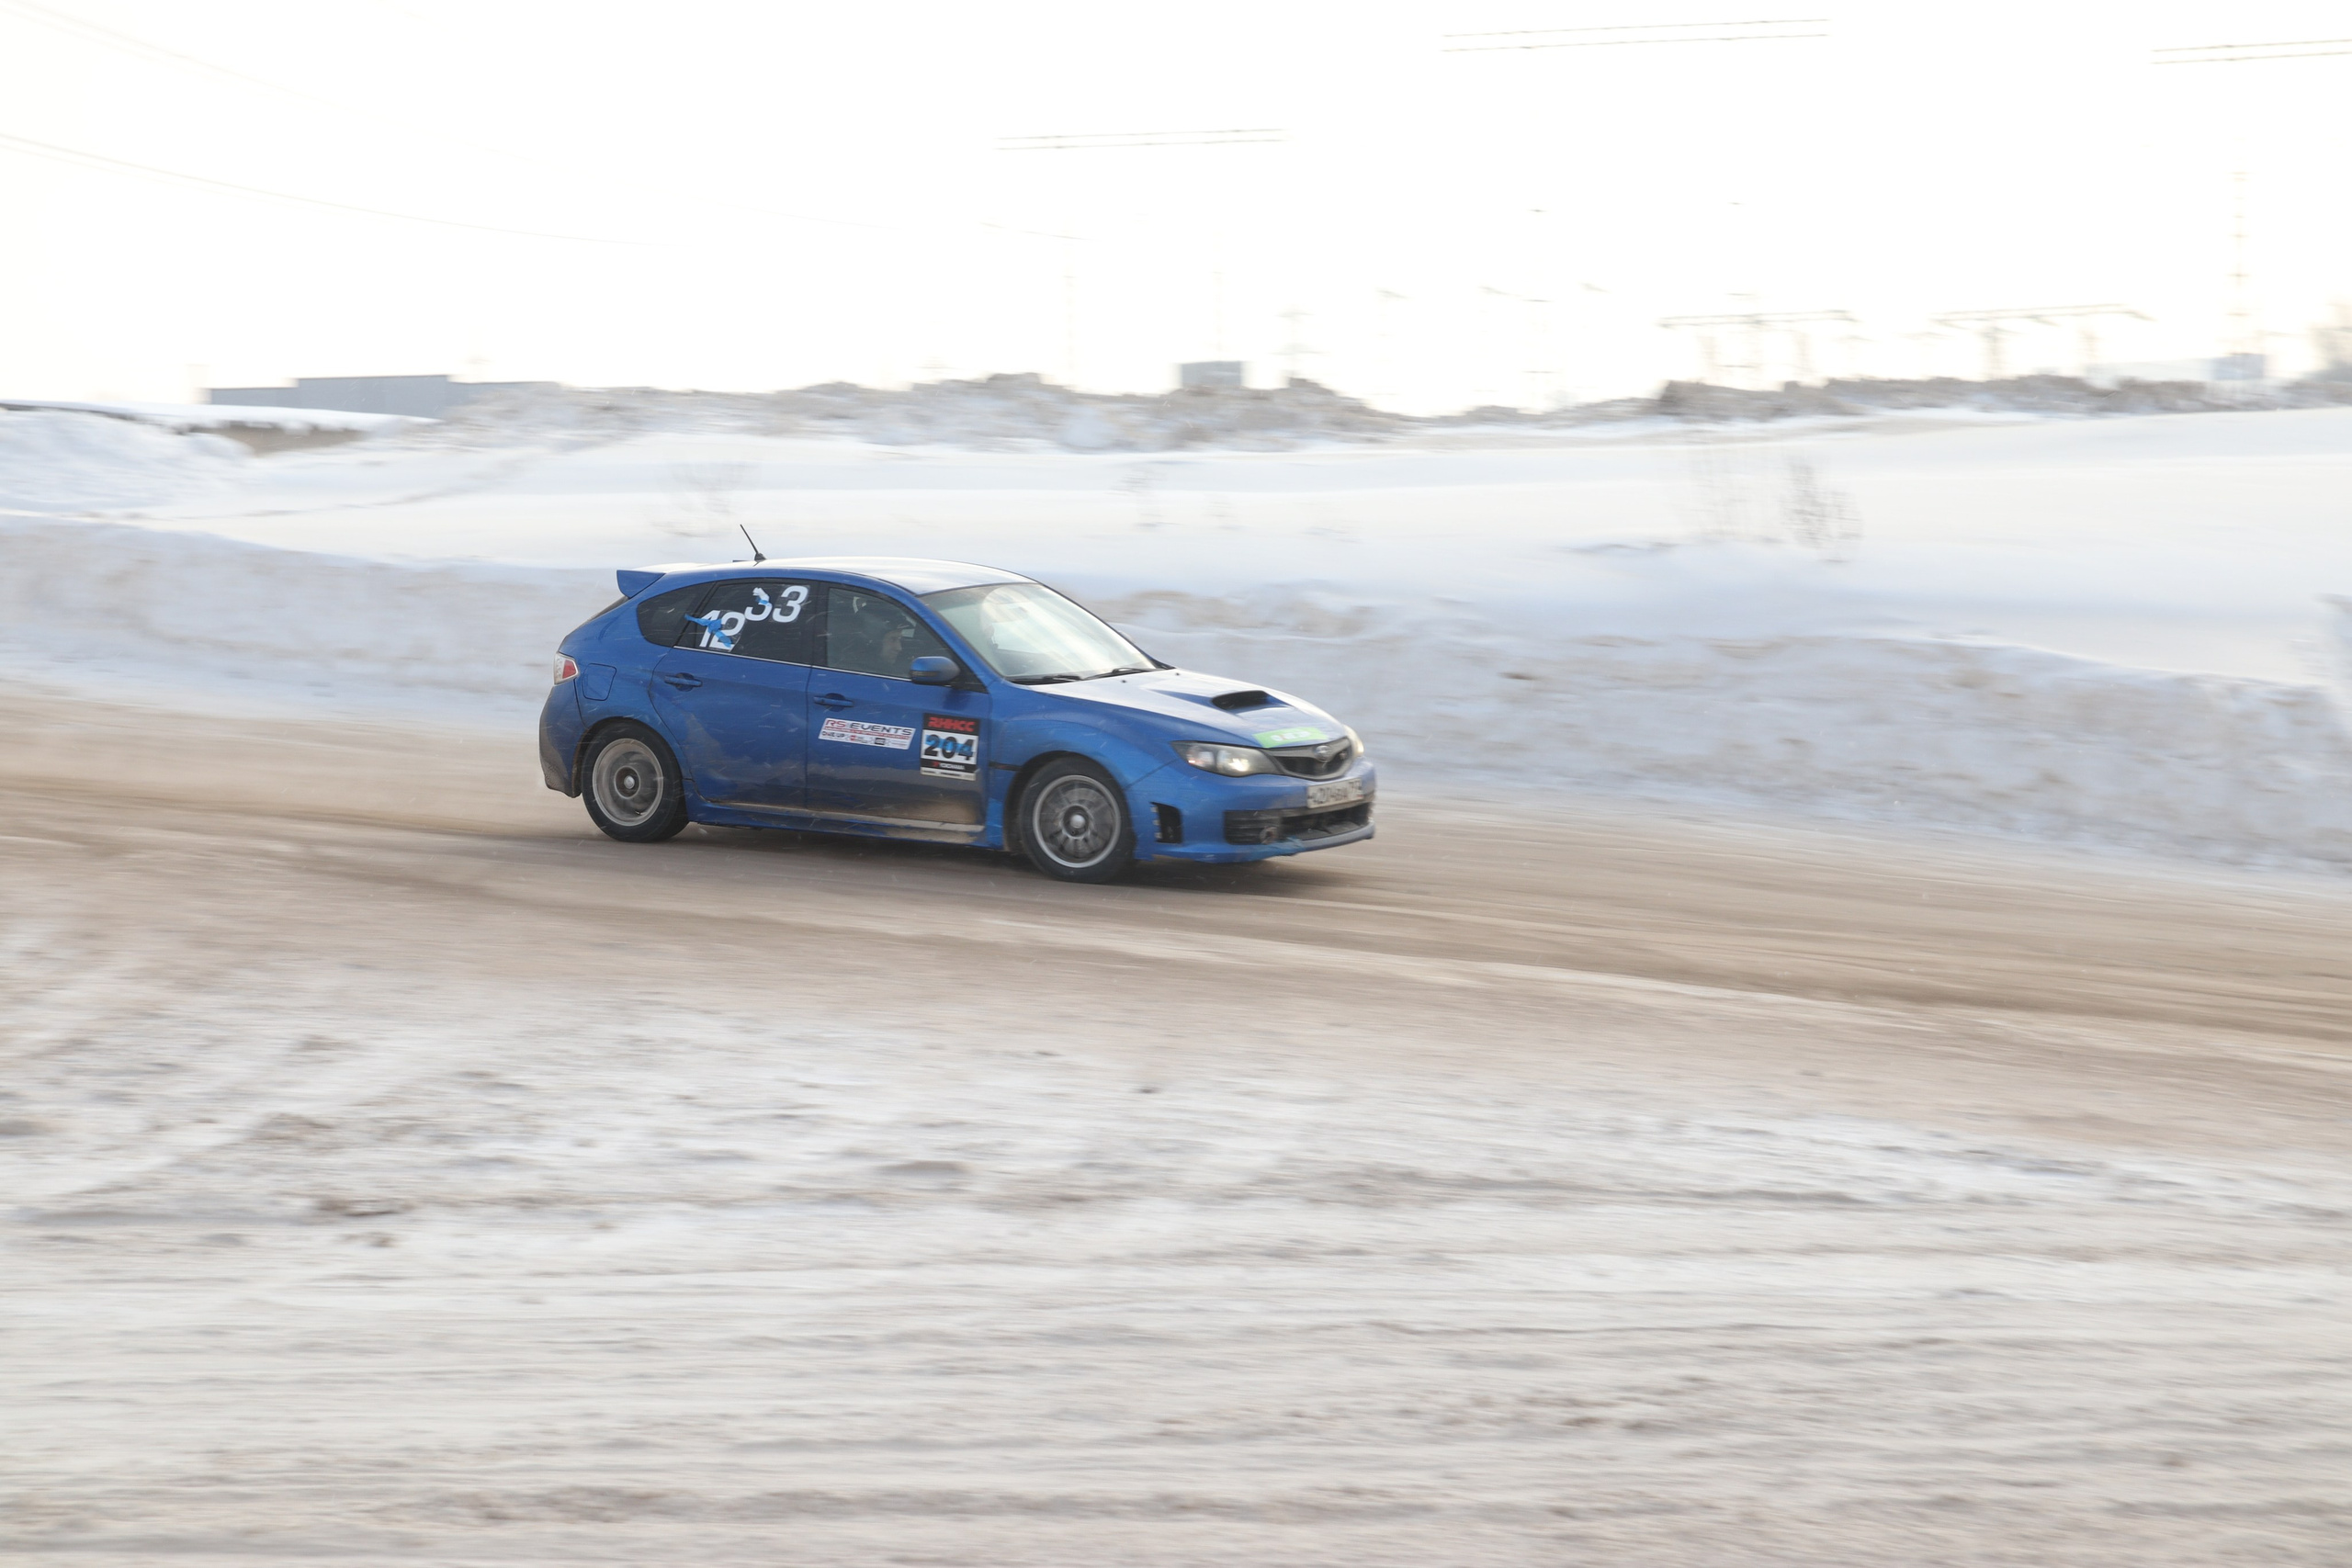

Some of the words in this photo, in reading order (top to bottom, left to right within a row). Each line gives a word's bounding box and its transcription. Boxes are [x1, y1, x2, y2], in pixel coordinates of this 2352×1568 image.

[826, 719, 846, 728] RS
[850, 722, 912, 736] EVENTS
[924, 734, 975, 761] 204
